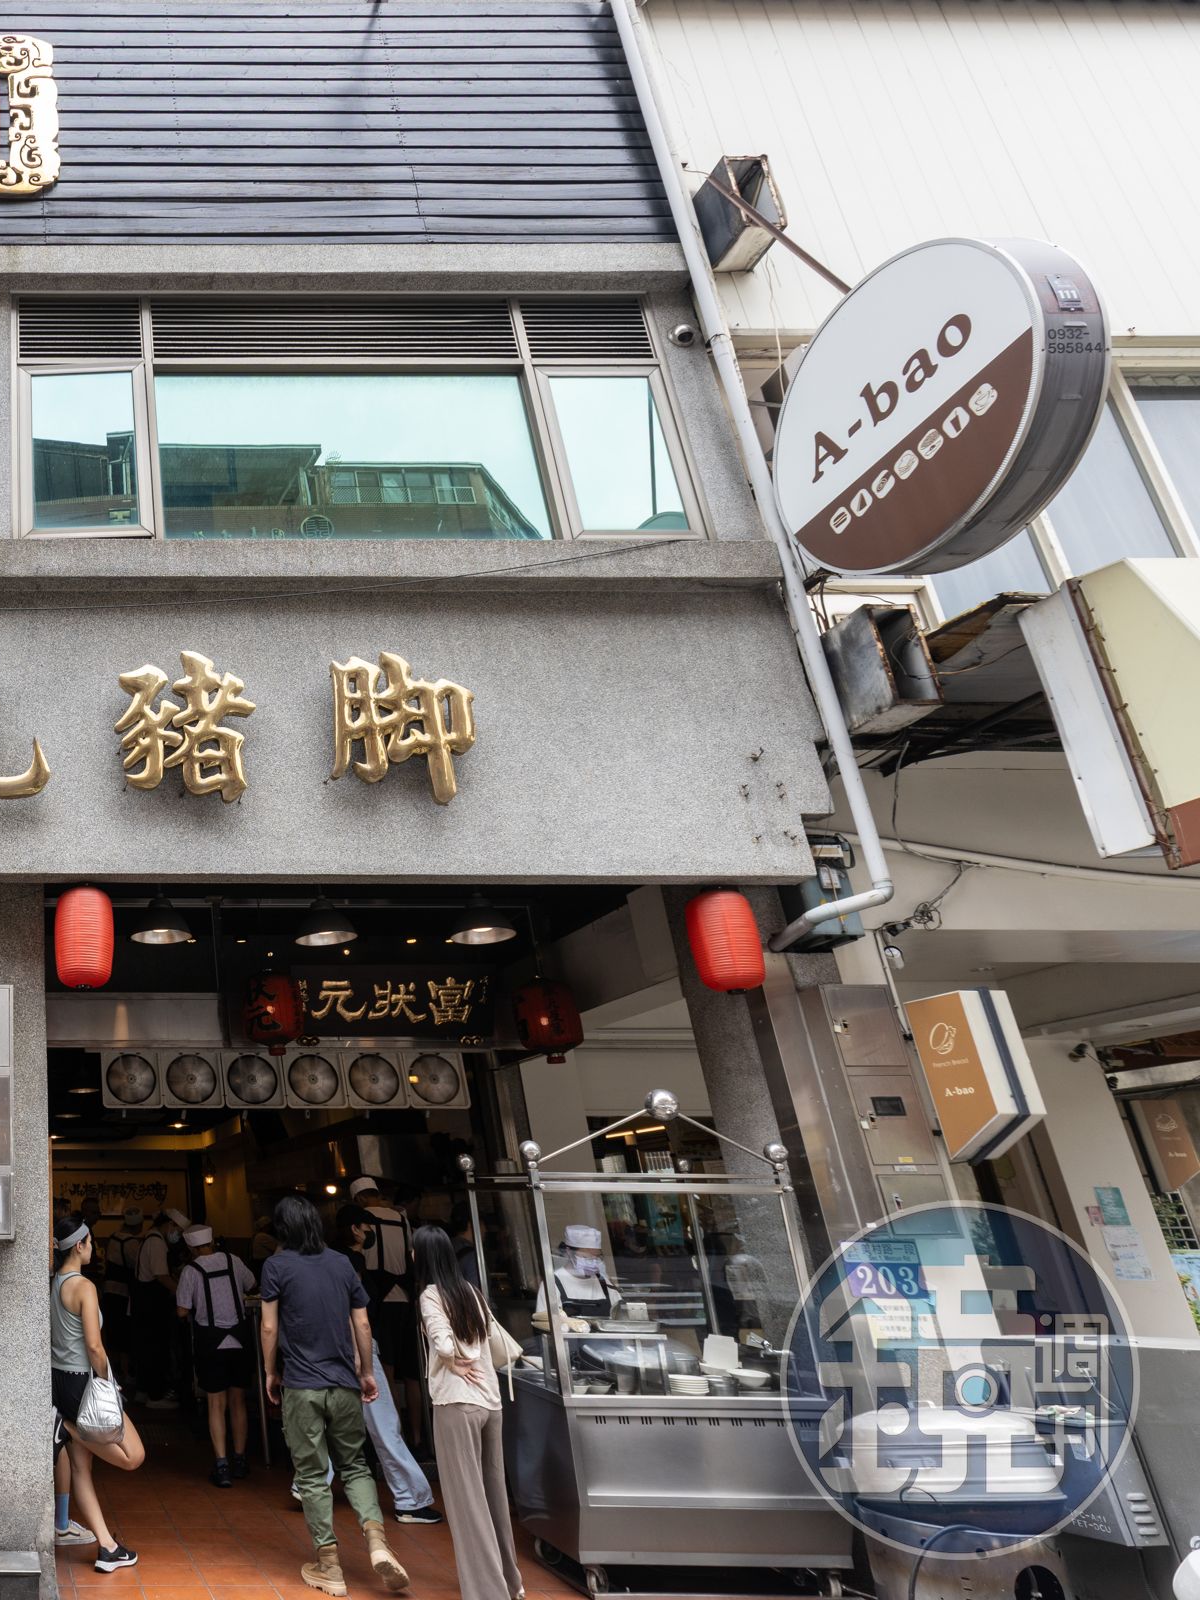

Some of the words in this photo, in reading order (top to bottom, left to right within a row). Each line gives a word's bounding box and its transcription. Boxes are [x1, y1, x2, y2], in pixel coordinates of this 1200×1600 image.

[1046, 328, 1090, 341] 0932-
[1046, 341, 1105, 355] 595844
[811, 312, 973, 485] A-bao
[944, 1086, 975, 1097] A-bao
[856, 1265, 919, 1296] 203
